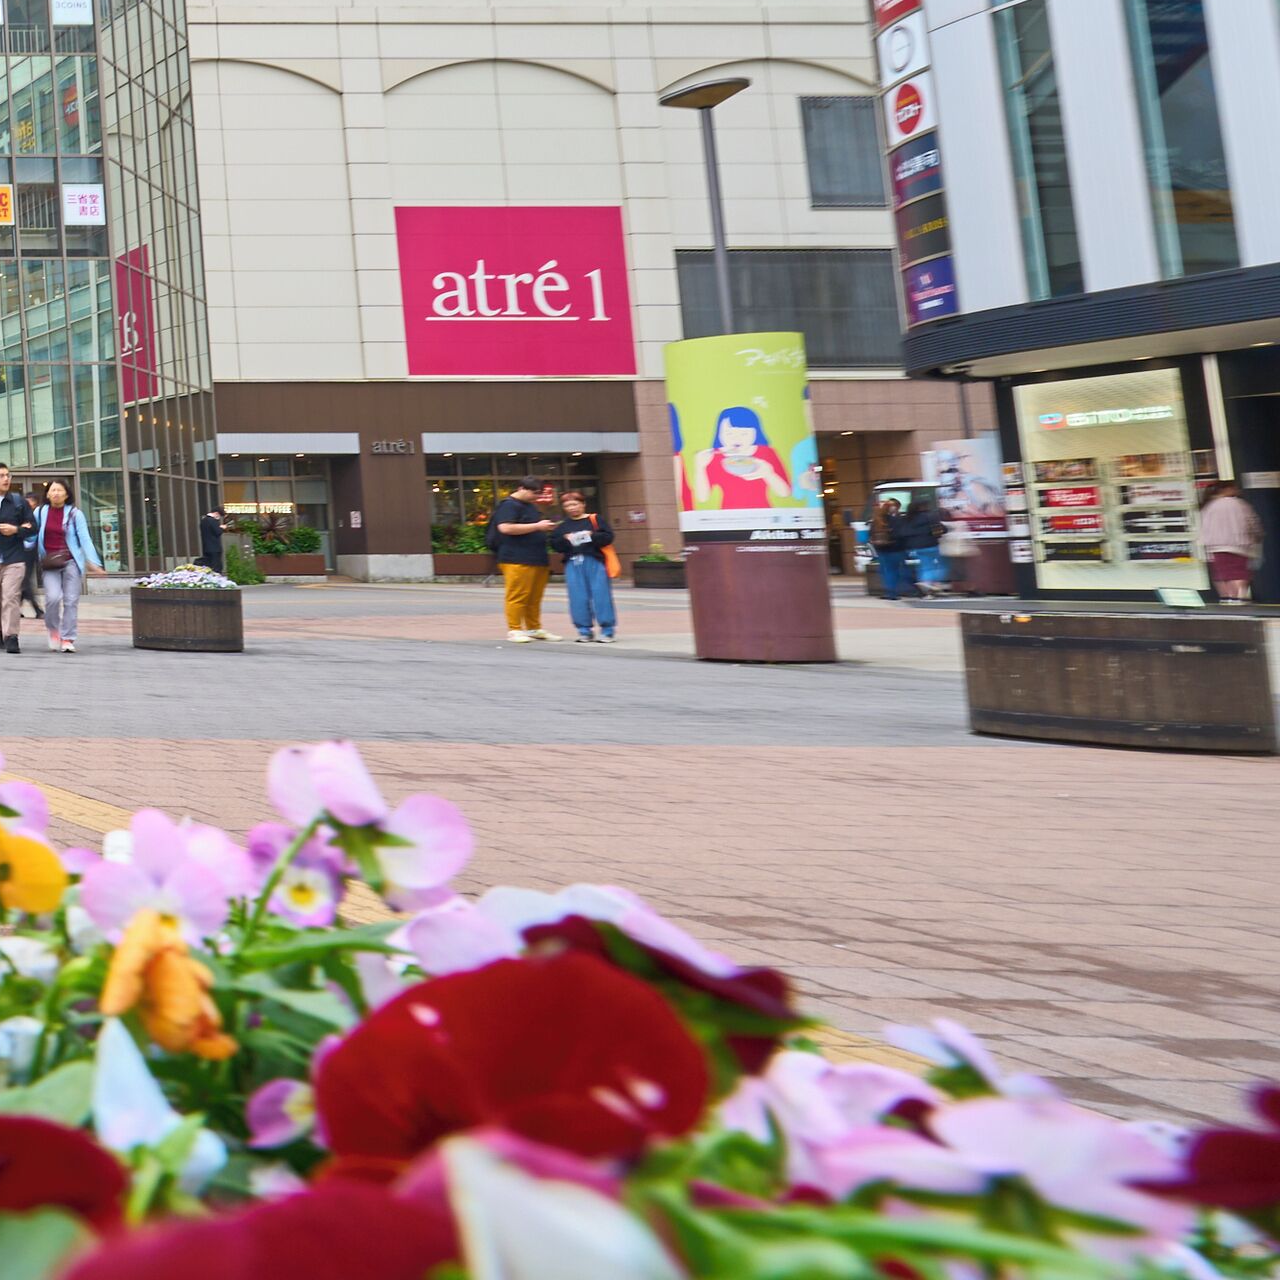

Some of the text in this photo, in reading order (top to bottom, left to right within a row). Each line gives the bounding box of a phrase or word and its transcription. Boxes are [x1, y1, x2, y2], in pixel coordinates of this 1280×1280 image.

[432, 259, 612, 321] atré 1
[372, 439, 405, 454] atré
